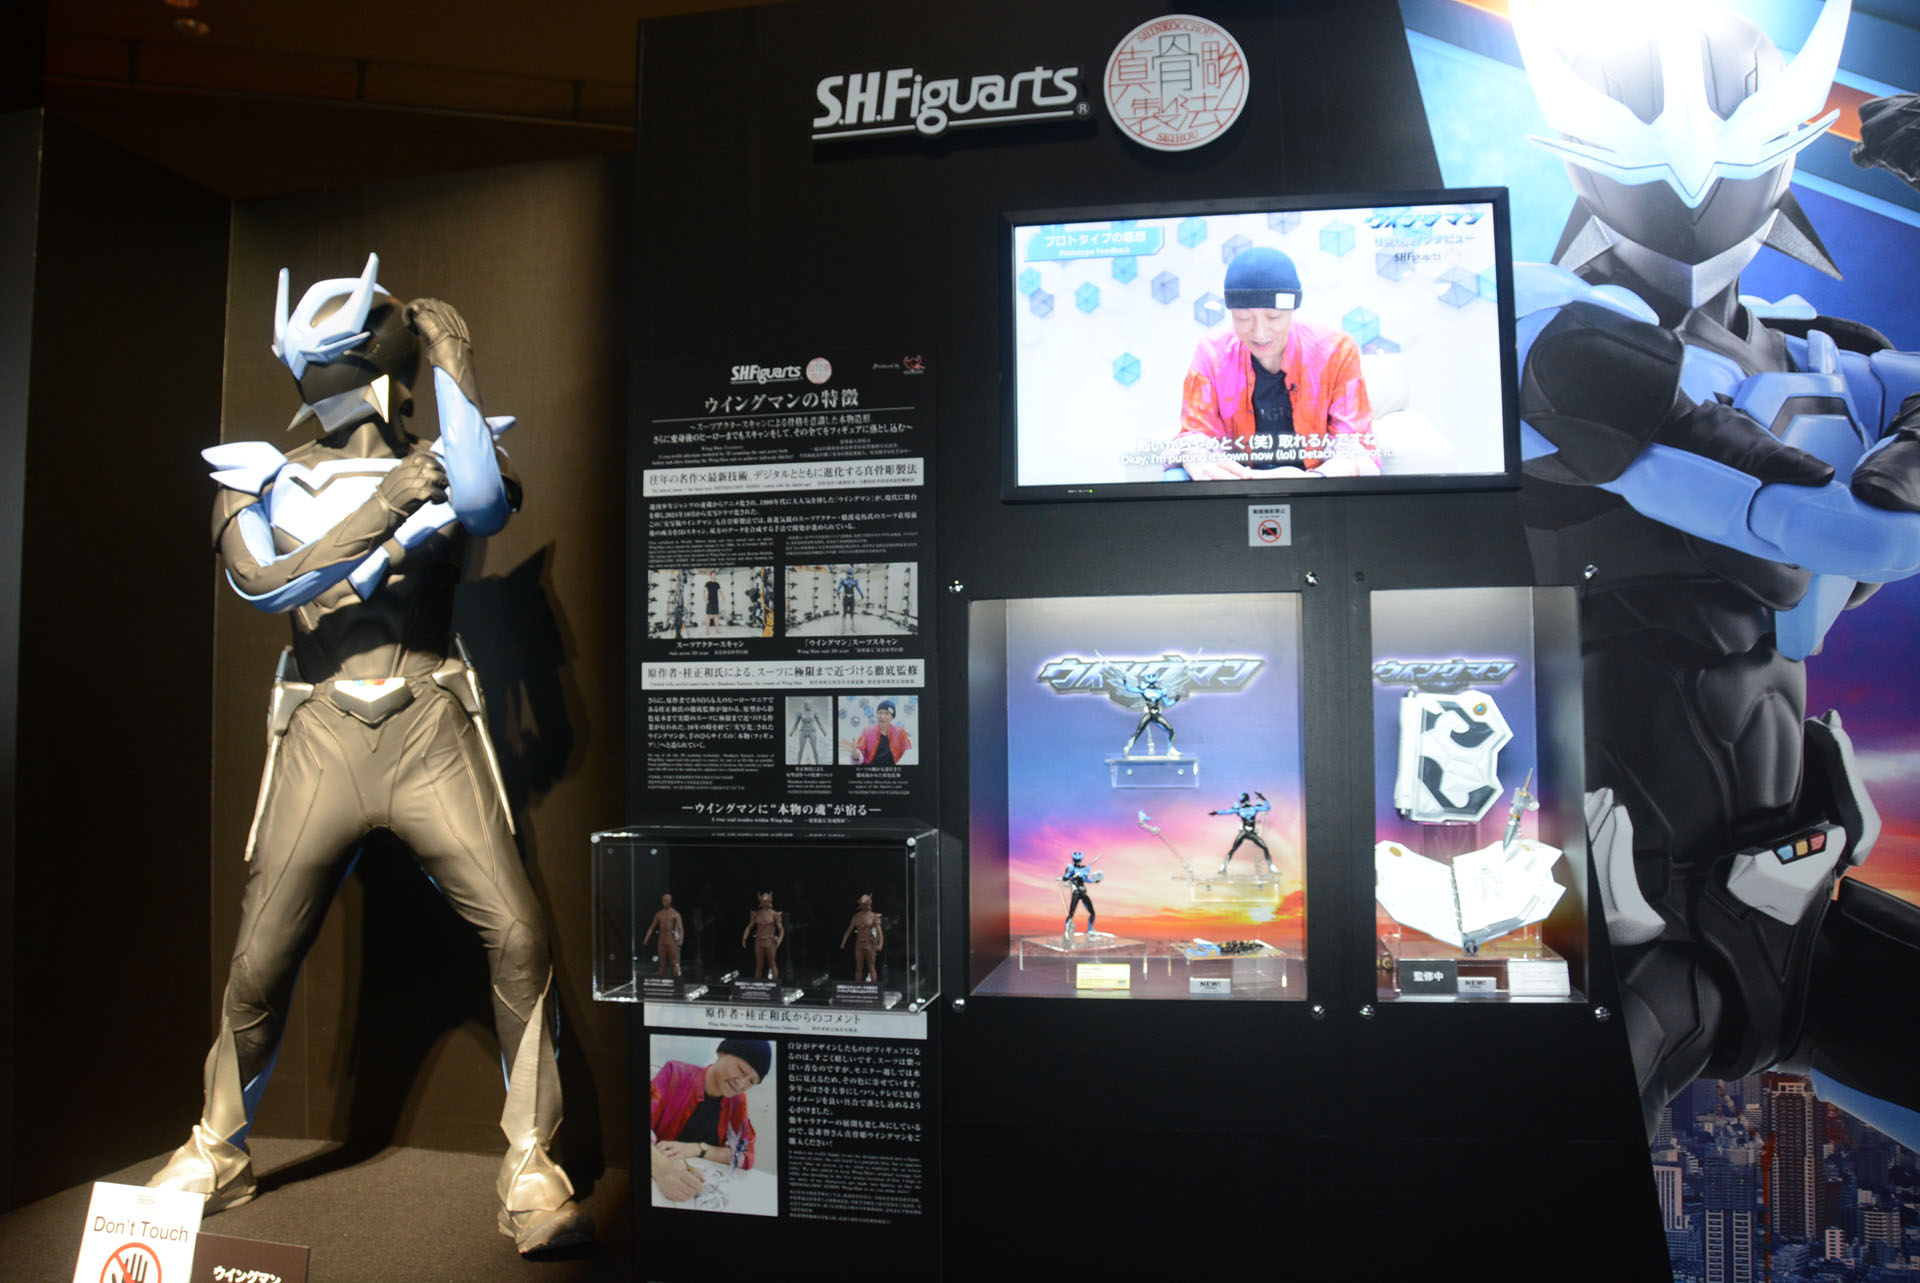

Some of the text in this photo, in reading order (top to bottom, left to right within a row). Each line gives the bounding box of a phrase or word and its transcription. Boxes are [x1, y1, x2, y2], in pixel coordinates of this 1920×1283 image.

[704, 388, 859, 414] ウイングマンの特徴
[1168, 453, 1206, 465] putting
[1219, 451, 1248, 462] down
[1251, 451, 1274, 460] now
[1276, 449, 1296, 461] (lol)
[1413, 971, 1445, 982] 監修中
[93, 1216, 189, 1243] Don't Touch
[213, 1265, 282, 1283] ウイングマン
